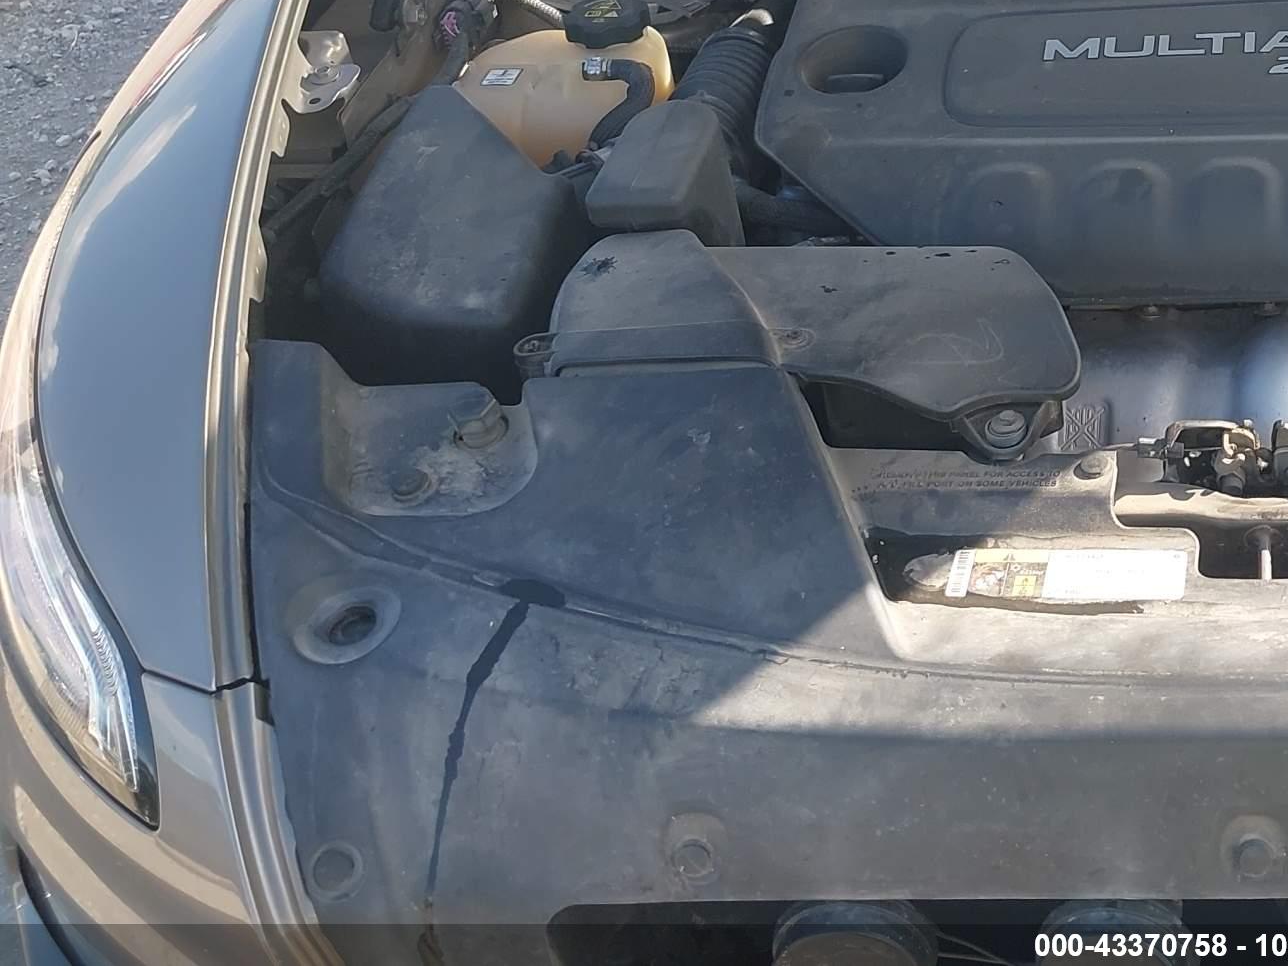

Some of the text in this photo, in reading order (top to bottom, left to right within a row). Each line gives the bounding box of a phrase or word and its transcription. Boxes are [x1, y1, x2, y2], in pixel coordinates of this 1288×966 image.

[983, 470, 1003, 478] FOR
[1006, 470, 1046, 478] ACCESS
[926, 480, 954, 488] PORT
[958, 480, 974, 488] ON
[976, 480, 1006, 488] SOME
[1009, 480, 1058, 488] VEHICLES
